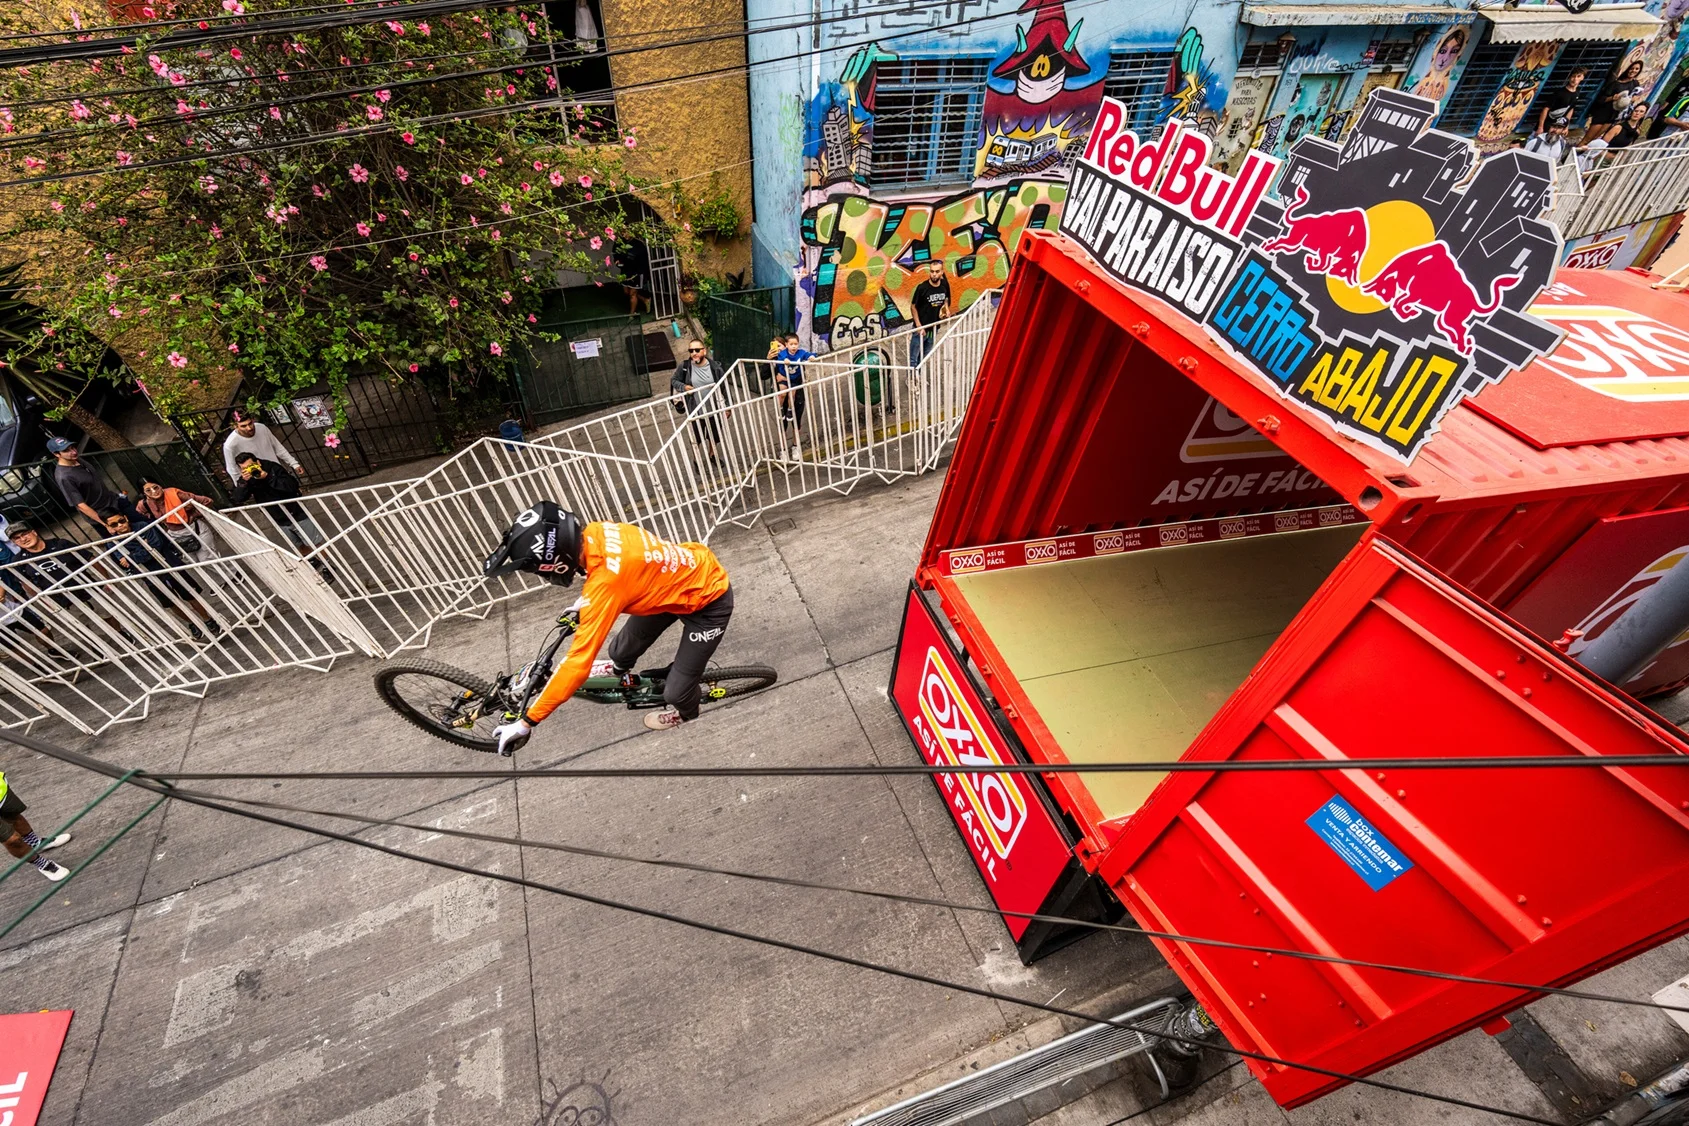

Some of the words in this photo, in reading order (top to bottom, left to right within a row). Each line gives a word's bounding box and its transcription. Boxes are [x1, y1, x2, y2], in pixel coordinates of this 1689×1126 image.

[1083, 100, 1178, 190] Red
[1158, 134, 1276, 237] Bull
[1063, 168, 1233, 315] VALPARAISO
[1213, 260, 1315, 383] CERRO
[1298, 347, 1458, 446] ABAJO
[1150, 467, 1224, 505] ASÍ
[1212, 473, 1261, 499] DE
[1257, 464, 1328, 494] FÁCI
[1221, 522, 1244, 535] OXXO
[1276, 516, 1298, 529] OXXO
[1320, 511, 1340, 523] OXXO
[1095, 536, 1123, 550] OXXO
[1161, 528, 1186, 542] OXXO
[952, 553, 983, 570] OXXO
[1026, 544, 1056, 560] OXXO
[1059, 548, 1076, 556] FÁCIL
[926, 673, 1012, 832] OXXO
[913, 715, 936, 757] ASÍ
[955, 793, 997, 882] FÁCIL
[1355, 819, 1374, 836] box
[1325, 818, 1344, 838] VENTA
[1349, 842, 1382, 873] ARRIENDO
[1349, 824, 1403, 871] contemar
